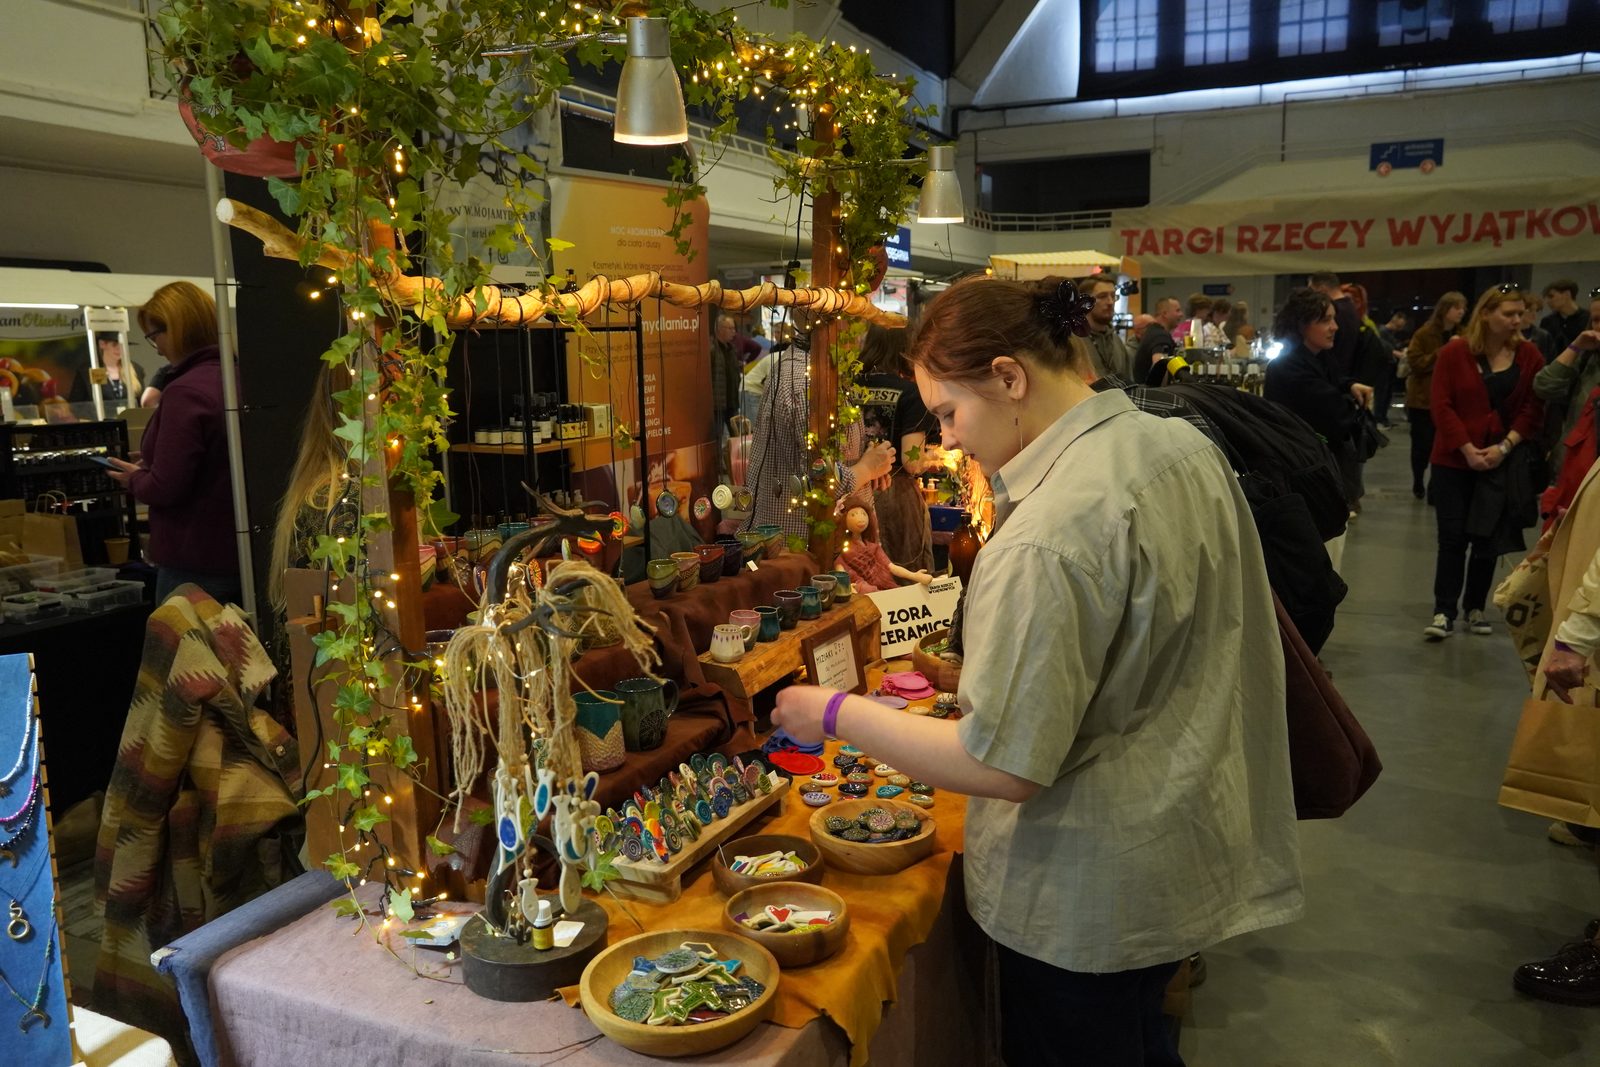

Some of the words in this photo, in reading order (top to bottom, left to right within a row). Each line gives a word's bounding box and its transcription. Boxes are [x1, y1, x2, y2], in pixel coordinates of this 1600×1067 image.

[1120, 227, 1224, 257] TARGI
[1236, 219, 1375, 253] RZECZY
[887, 604, 932, 625] ZORA
